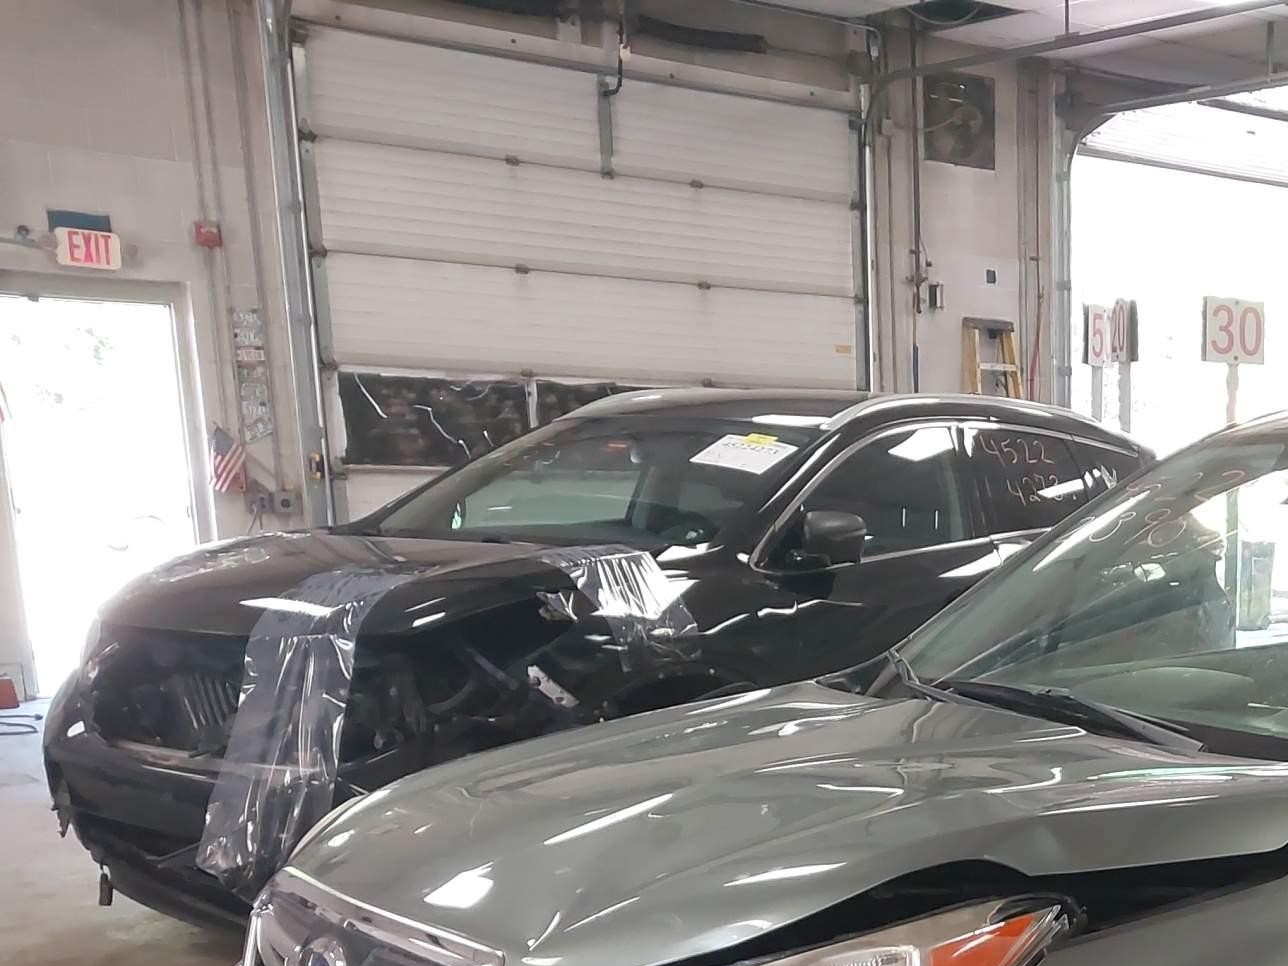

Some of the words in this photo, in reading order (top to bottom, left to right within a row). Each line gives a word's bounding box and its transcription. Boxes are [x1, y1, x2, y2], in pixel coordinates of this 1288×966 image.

[67, 230, 112, 266] EXIT
[1111, 304, 1125, 353] 20
[1210, 304, 1262, 356] 30
[979, 435, 1055, 468] 4522
